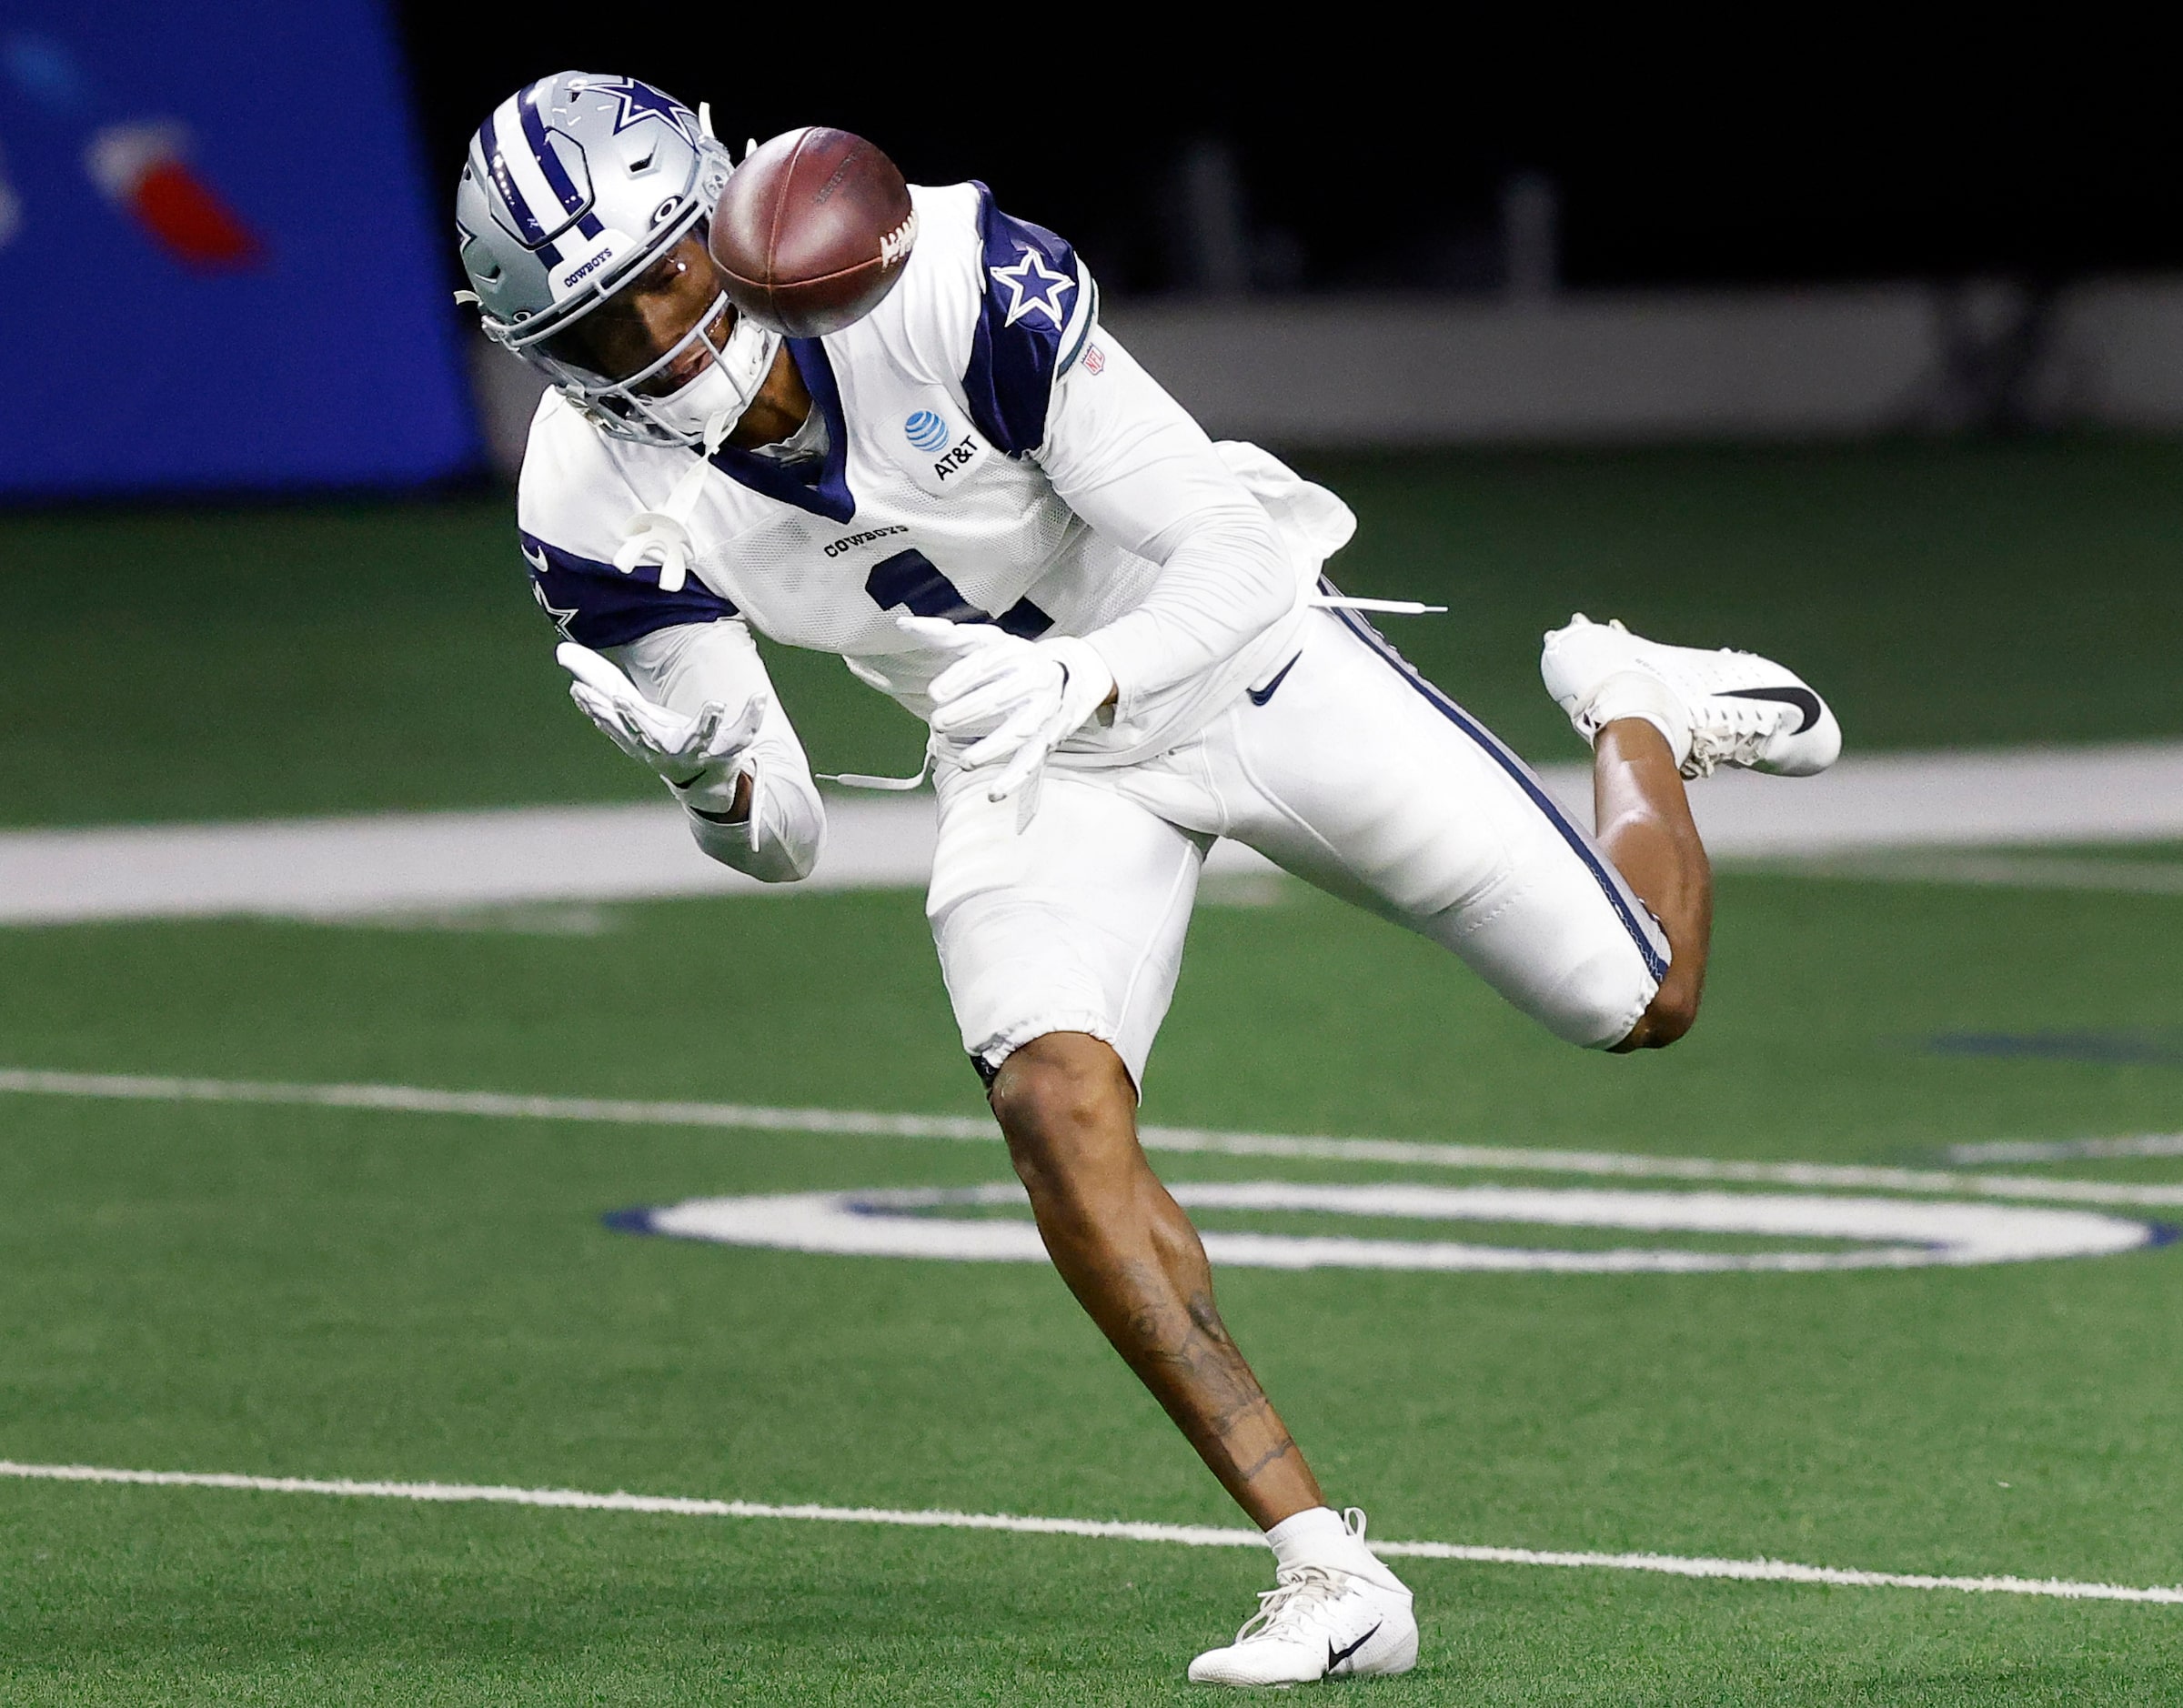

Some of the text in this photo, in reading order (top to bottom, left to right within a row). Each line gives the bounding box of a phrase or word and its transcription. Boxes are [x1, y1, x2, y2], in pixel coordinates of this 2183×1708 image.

[564, 247, 613, 288] COWBOYS
[934, 434, 979, 481] AT&T
[824, 525, 910, 558] COWBOYS
